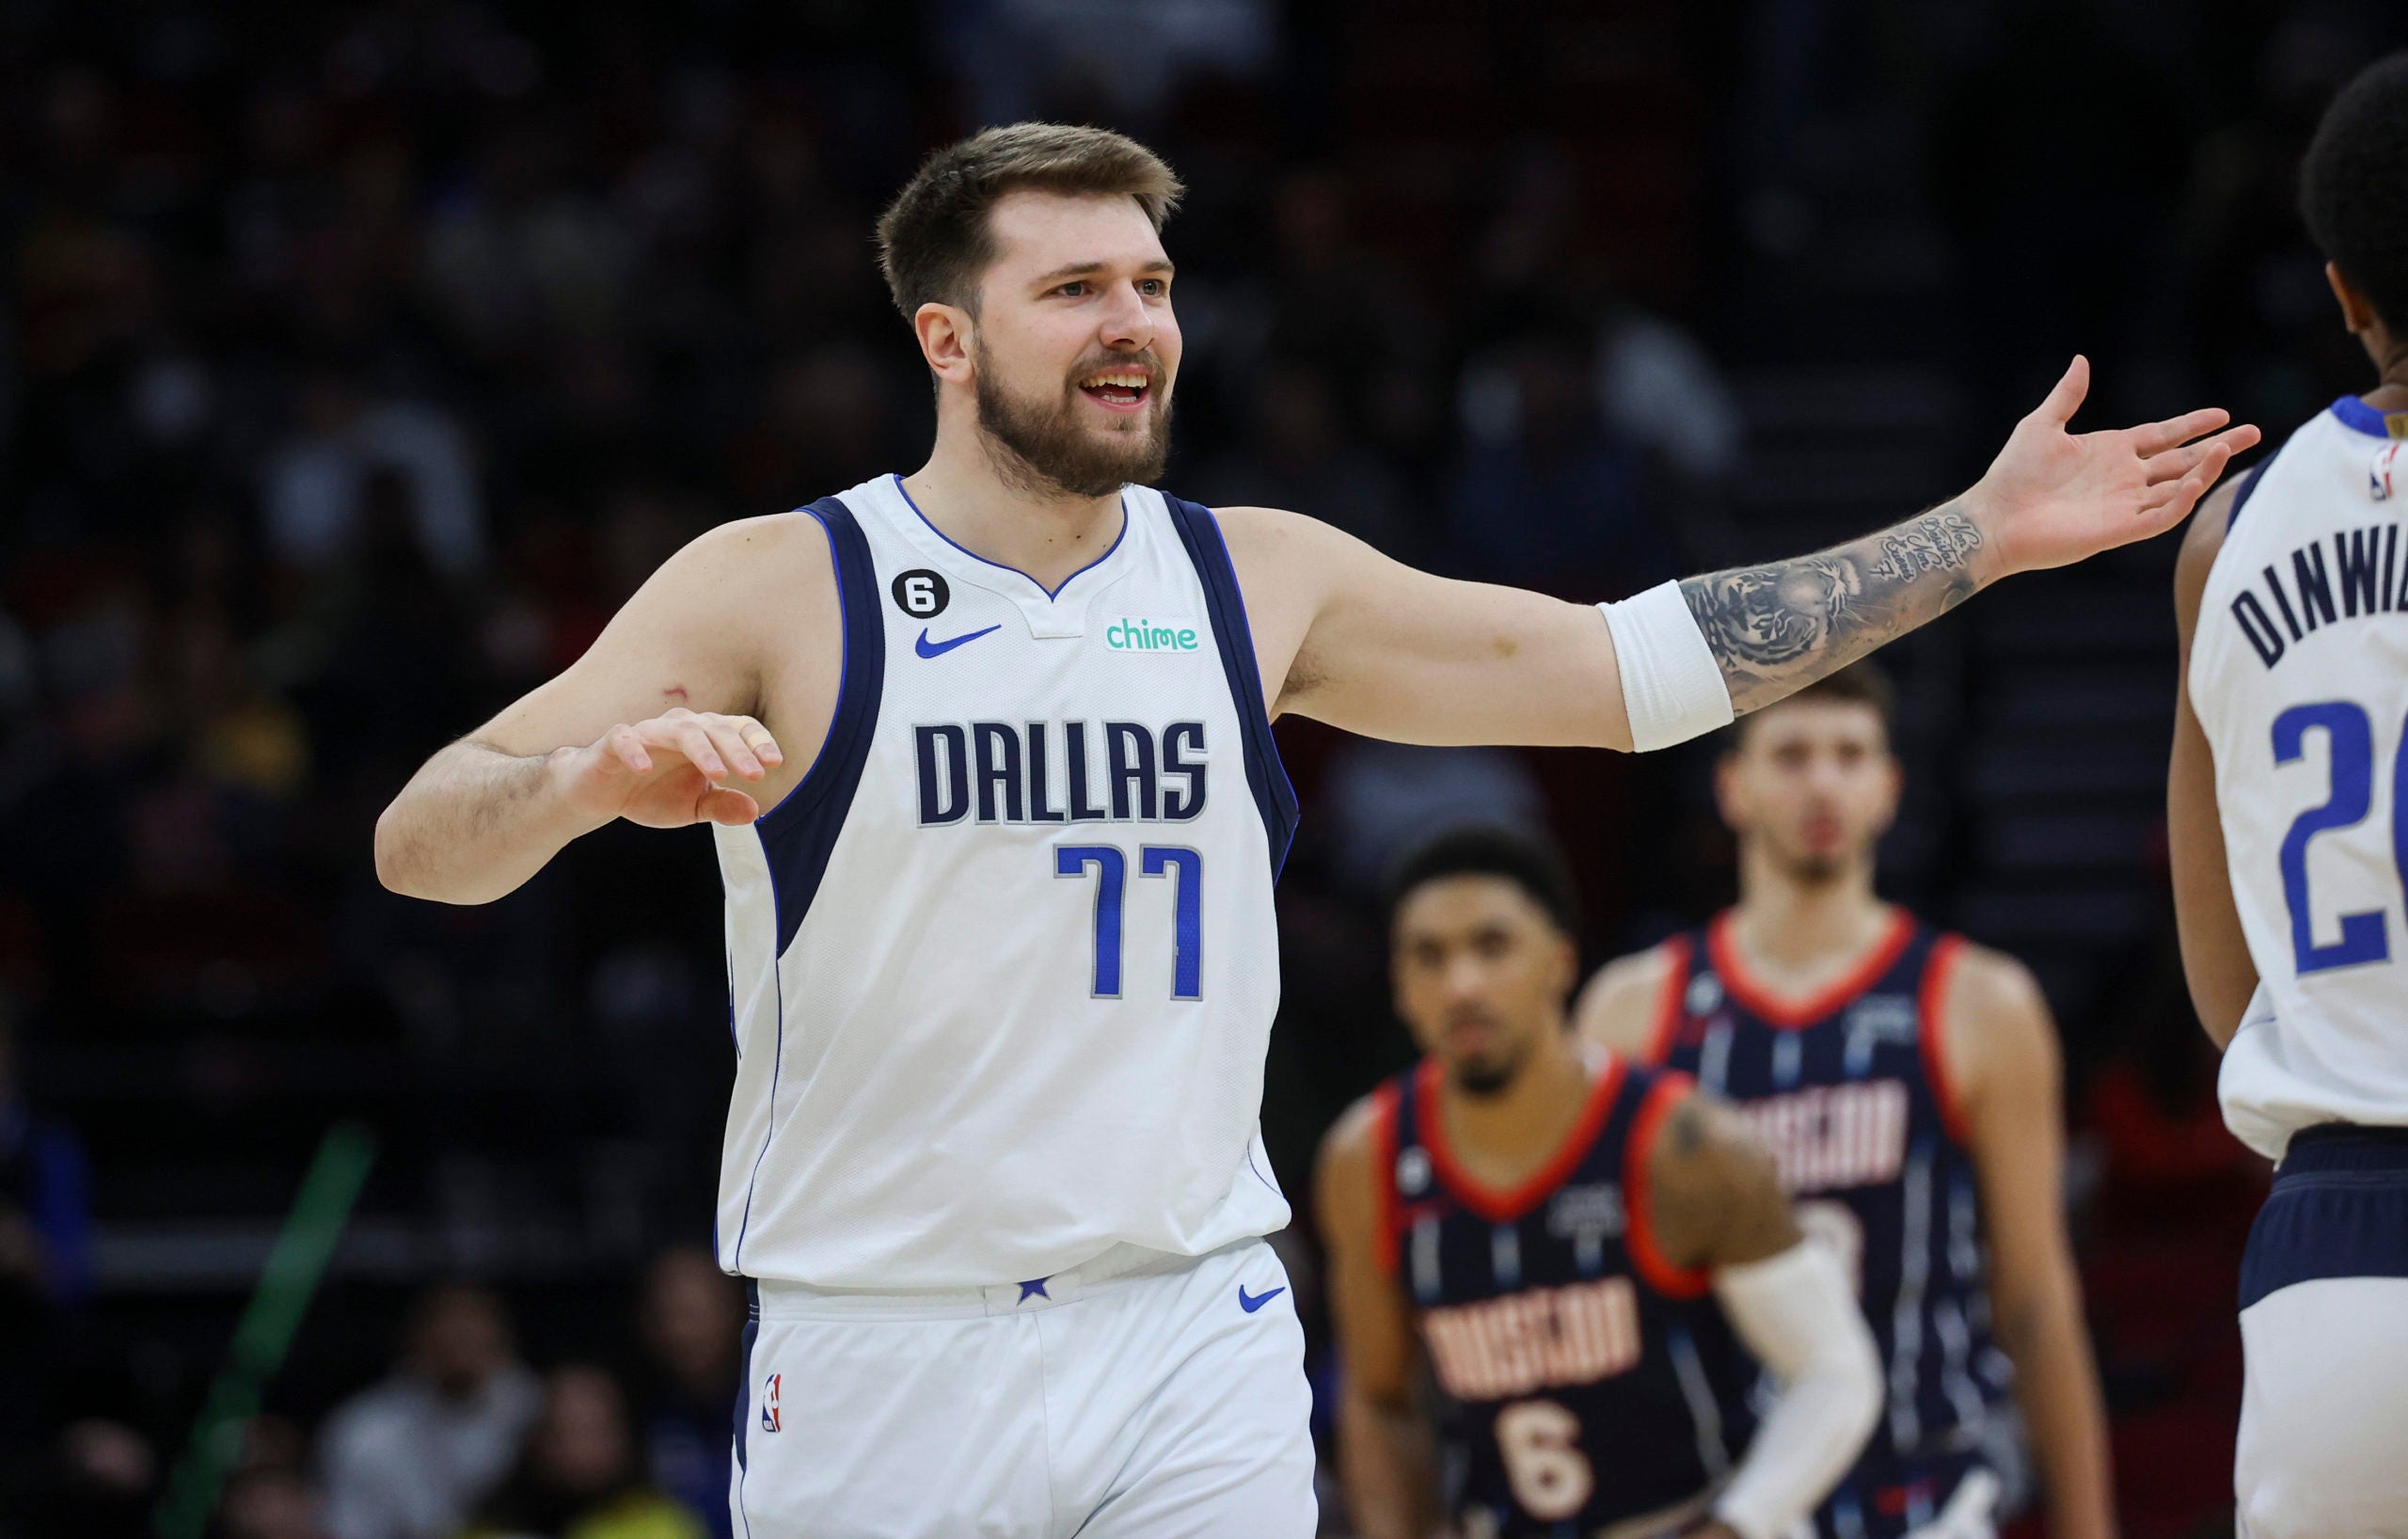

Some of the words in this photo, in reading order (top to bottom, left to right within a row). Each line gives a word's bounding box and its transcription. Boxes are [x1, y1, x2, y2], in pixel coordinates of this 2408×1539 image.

[904, 576, 937, 612] 6
[1106, 618, 1198, 650] chime
[911, 718, 1210, 829] DALLAS
[2270, 699, 2408, 979] 2
[1052, 842, 1205, 1002] 77
[1495, 1398, 1594, 1523] 6
